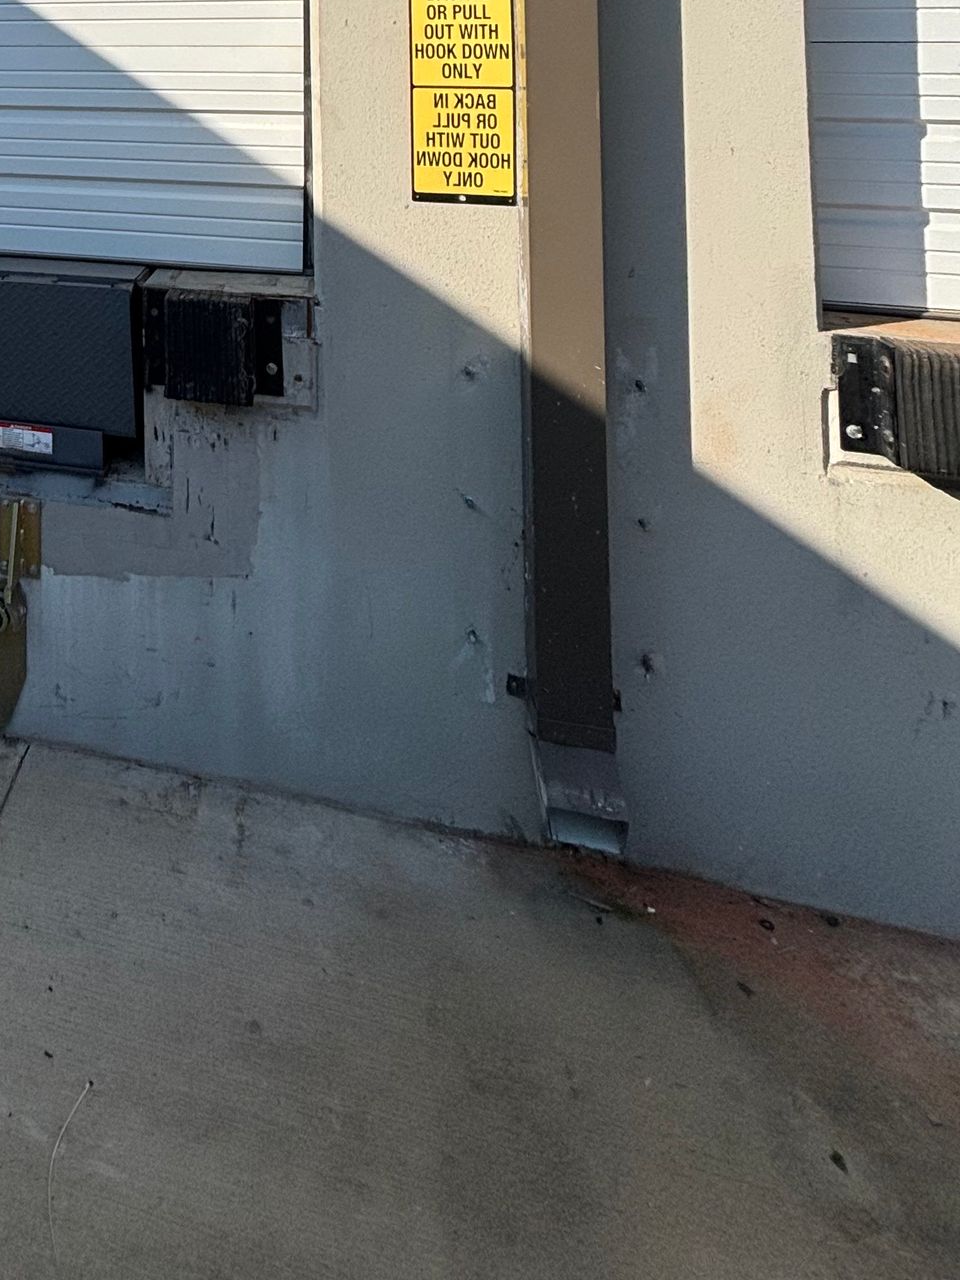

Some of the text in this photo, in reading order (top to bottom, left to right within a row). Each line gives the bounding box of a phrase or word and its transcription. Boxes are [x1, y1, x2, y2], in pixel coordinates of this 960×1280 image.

[426, 4, 491, 20] OR PULL
[424, 24, 498, 40] OUT WITH
[415, 43, 510, 59] HOOK DOWN
[442, 63, 482, 79] ONLY
